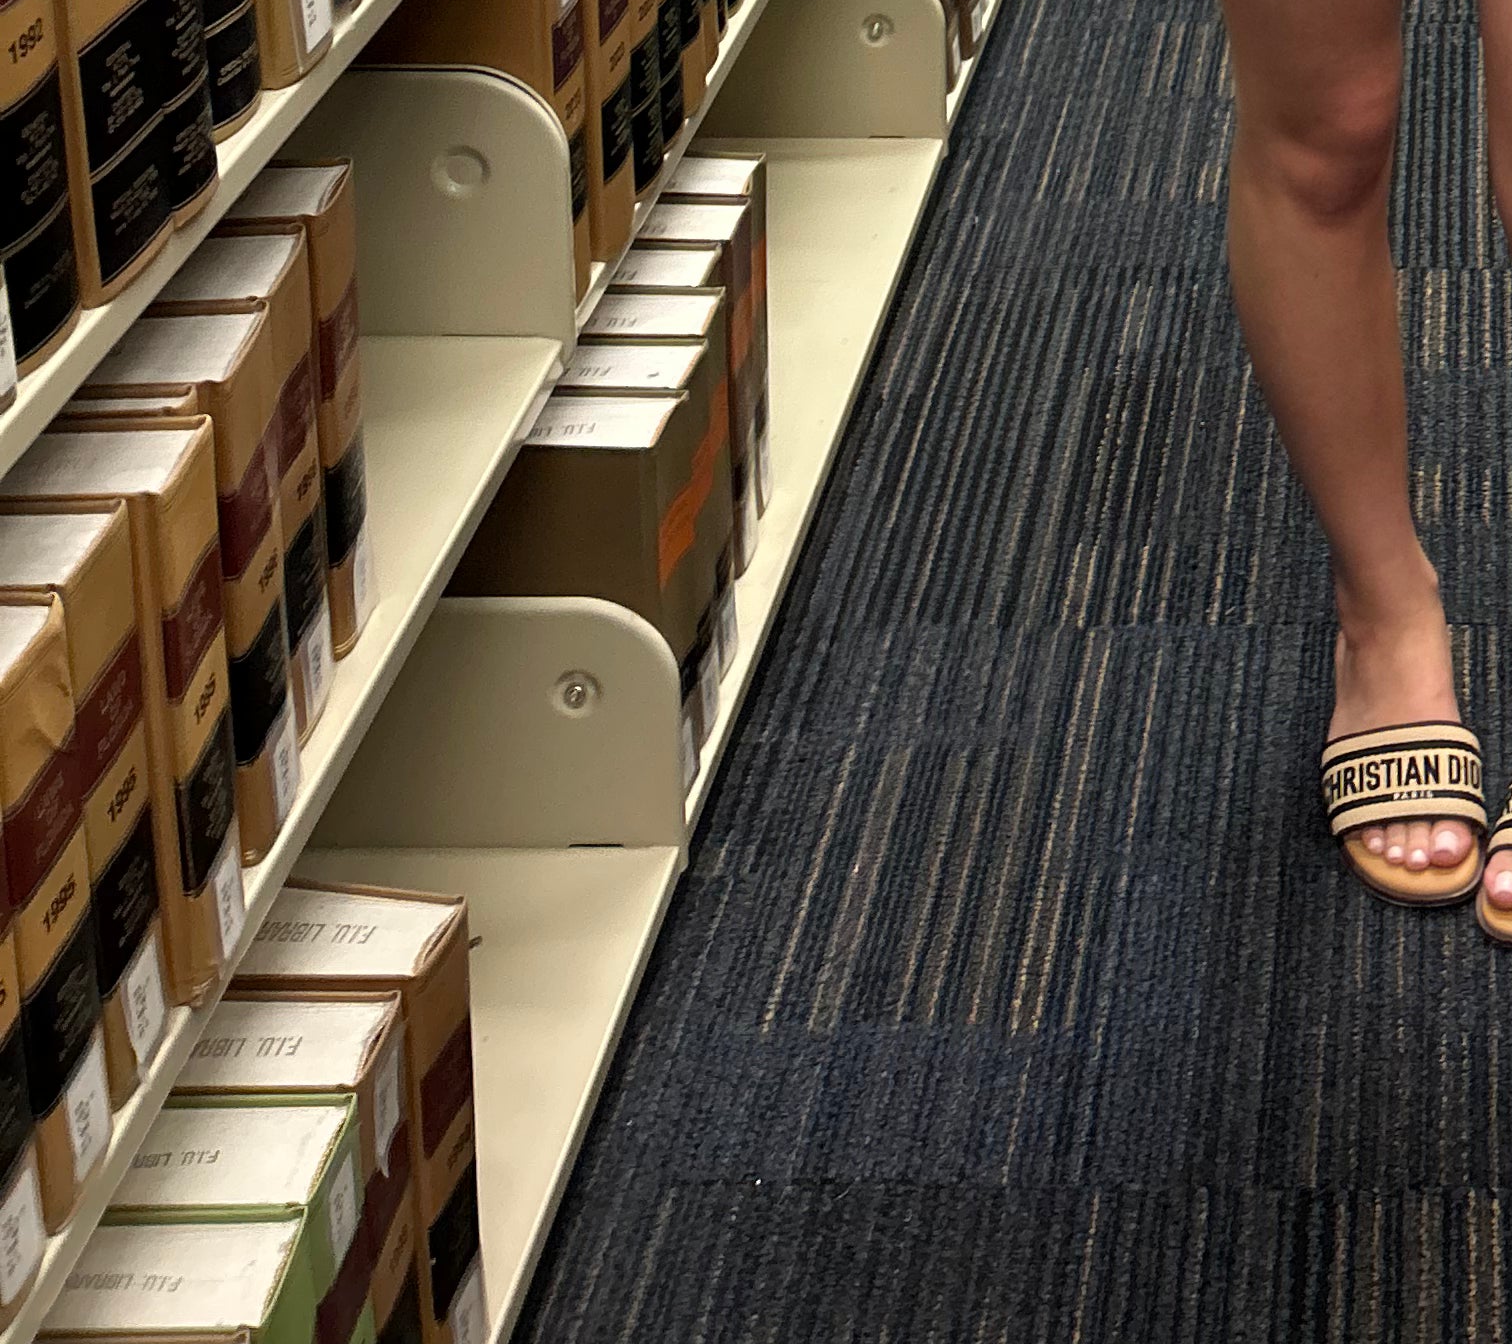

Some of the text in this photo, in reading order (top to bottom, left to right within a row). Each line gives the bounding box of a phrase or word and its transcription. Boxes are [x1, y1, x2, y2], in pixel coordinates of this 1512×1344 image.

[8, 18, 44, 65] 1992
[1448, 755, 1483, 787] DIO
[1393, 789, 1435, 802] PARIS
[42, 874, 79, 935] 1995
[256, 918, 378, 946] F.I.U. LIBRAR
[195, 1035, 304, 1059] F.I.U. LIBRA
[132, 1147, 223, 1169] F.I.U. LIBR
